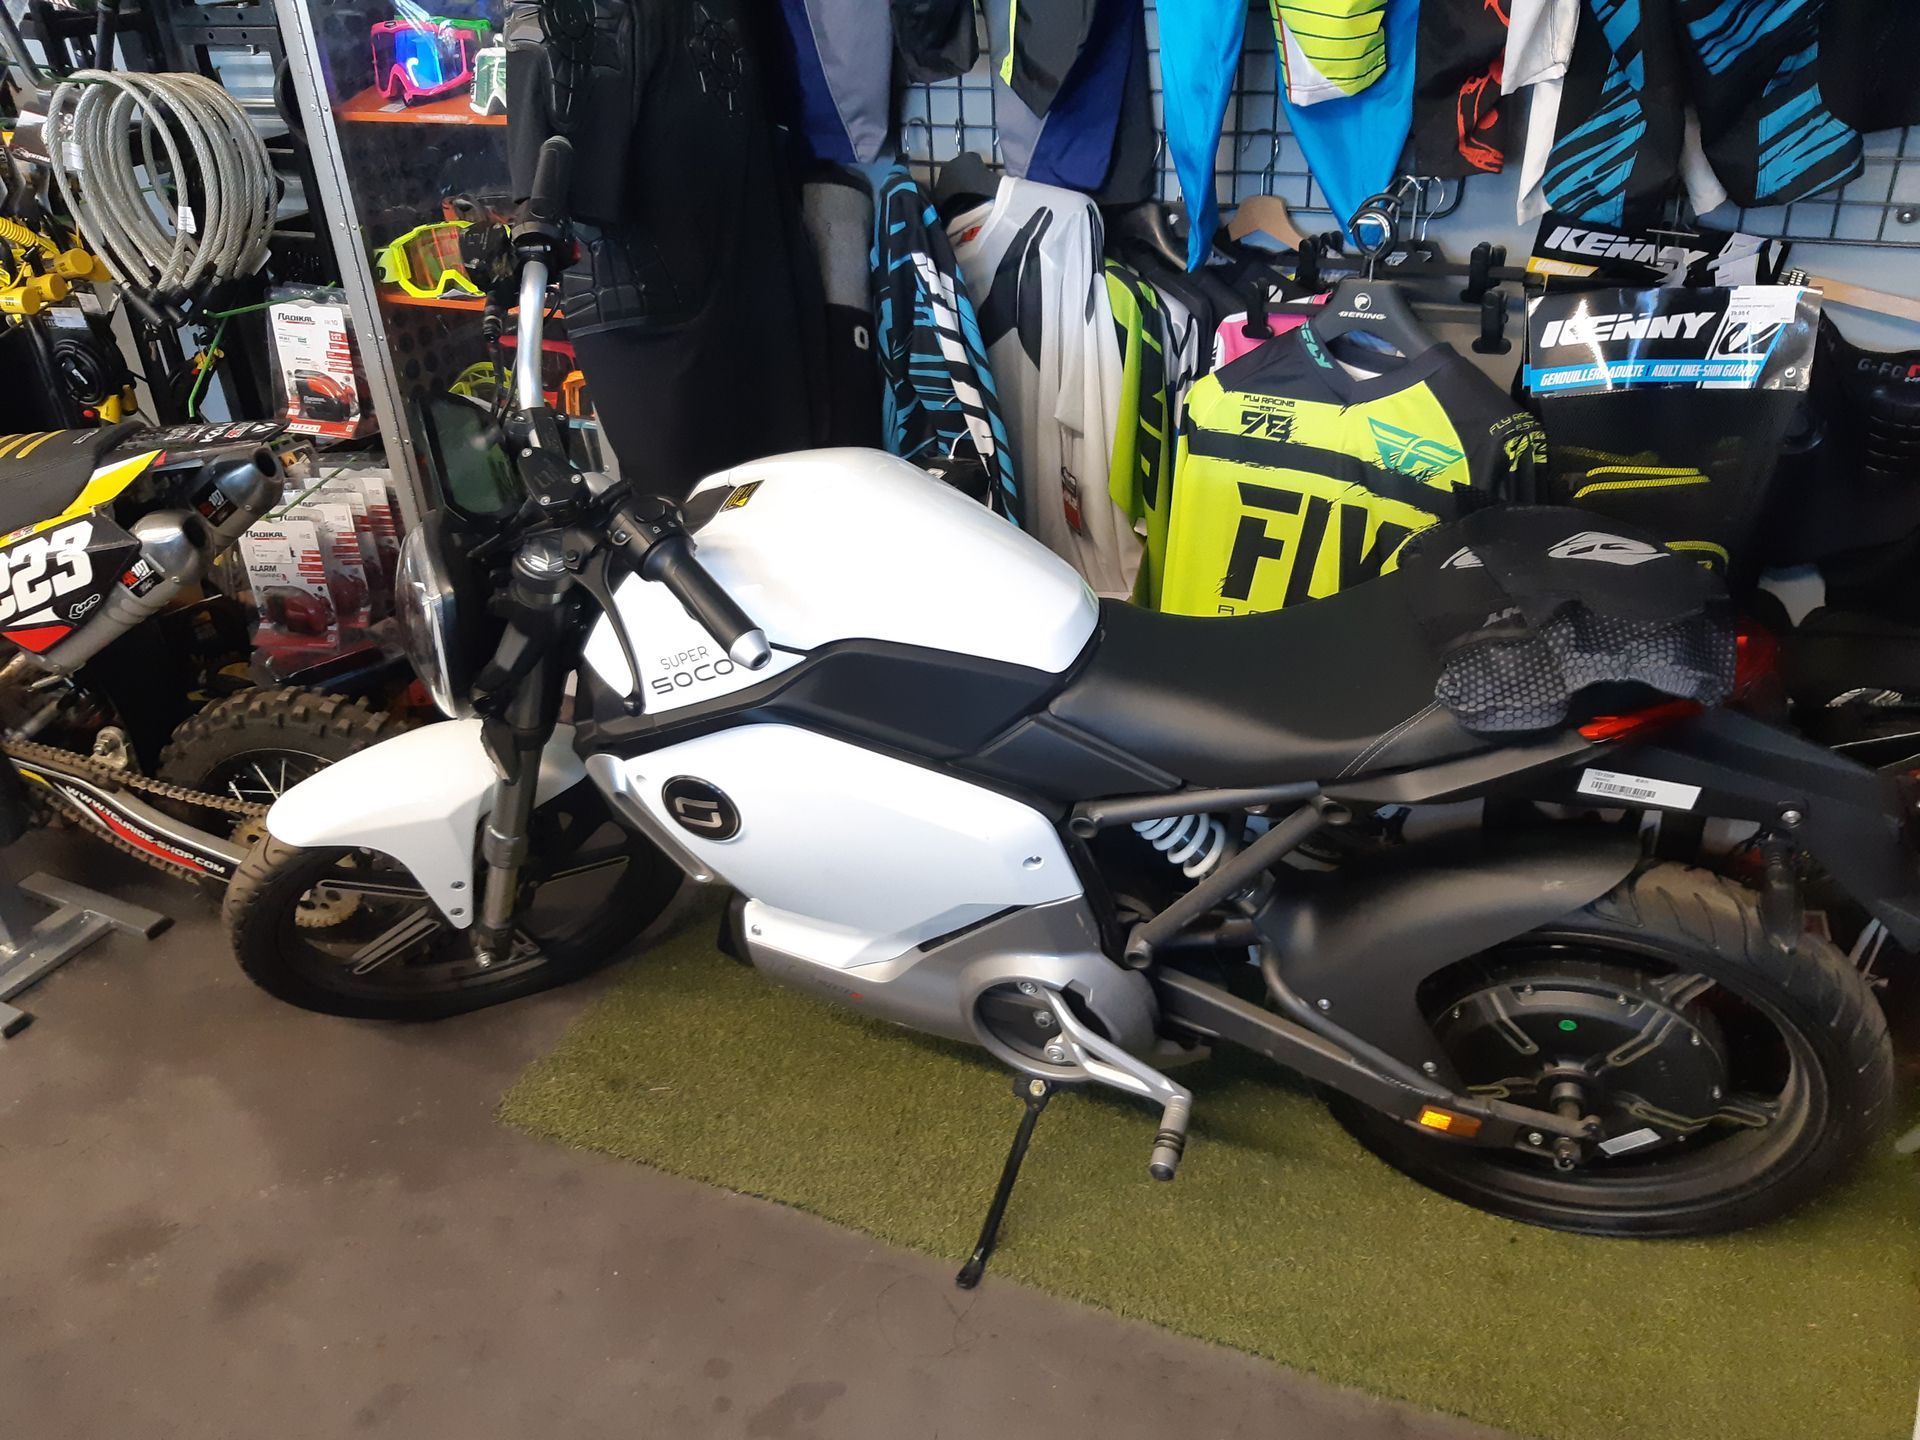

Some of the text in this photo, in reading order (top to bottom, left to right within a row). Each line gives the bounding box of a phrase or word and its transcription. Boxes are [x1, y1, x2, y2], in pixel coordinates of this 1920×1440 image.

[277, 312, 314, 323] RADIKAL
[1338, 310, 1387, 320] BERING
[1539, 310, 1716, 349] KENNY
[1651, 364, 1681, 377] ADULT
[1722, 364, 1760, 377] GUARD
[1243, 394, 1296, 408] FLY RACING
[1259, 405, 1277, 413] EST
[245, 530, 287, 538] RADIKAL
[249, 564, 277, 573] ALARM
[660, 645, 710, 671] SUPER
[651, 658, 735, 695] SOCO
